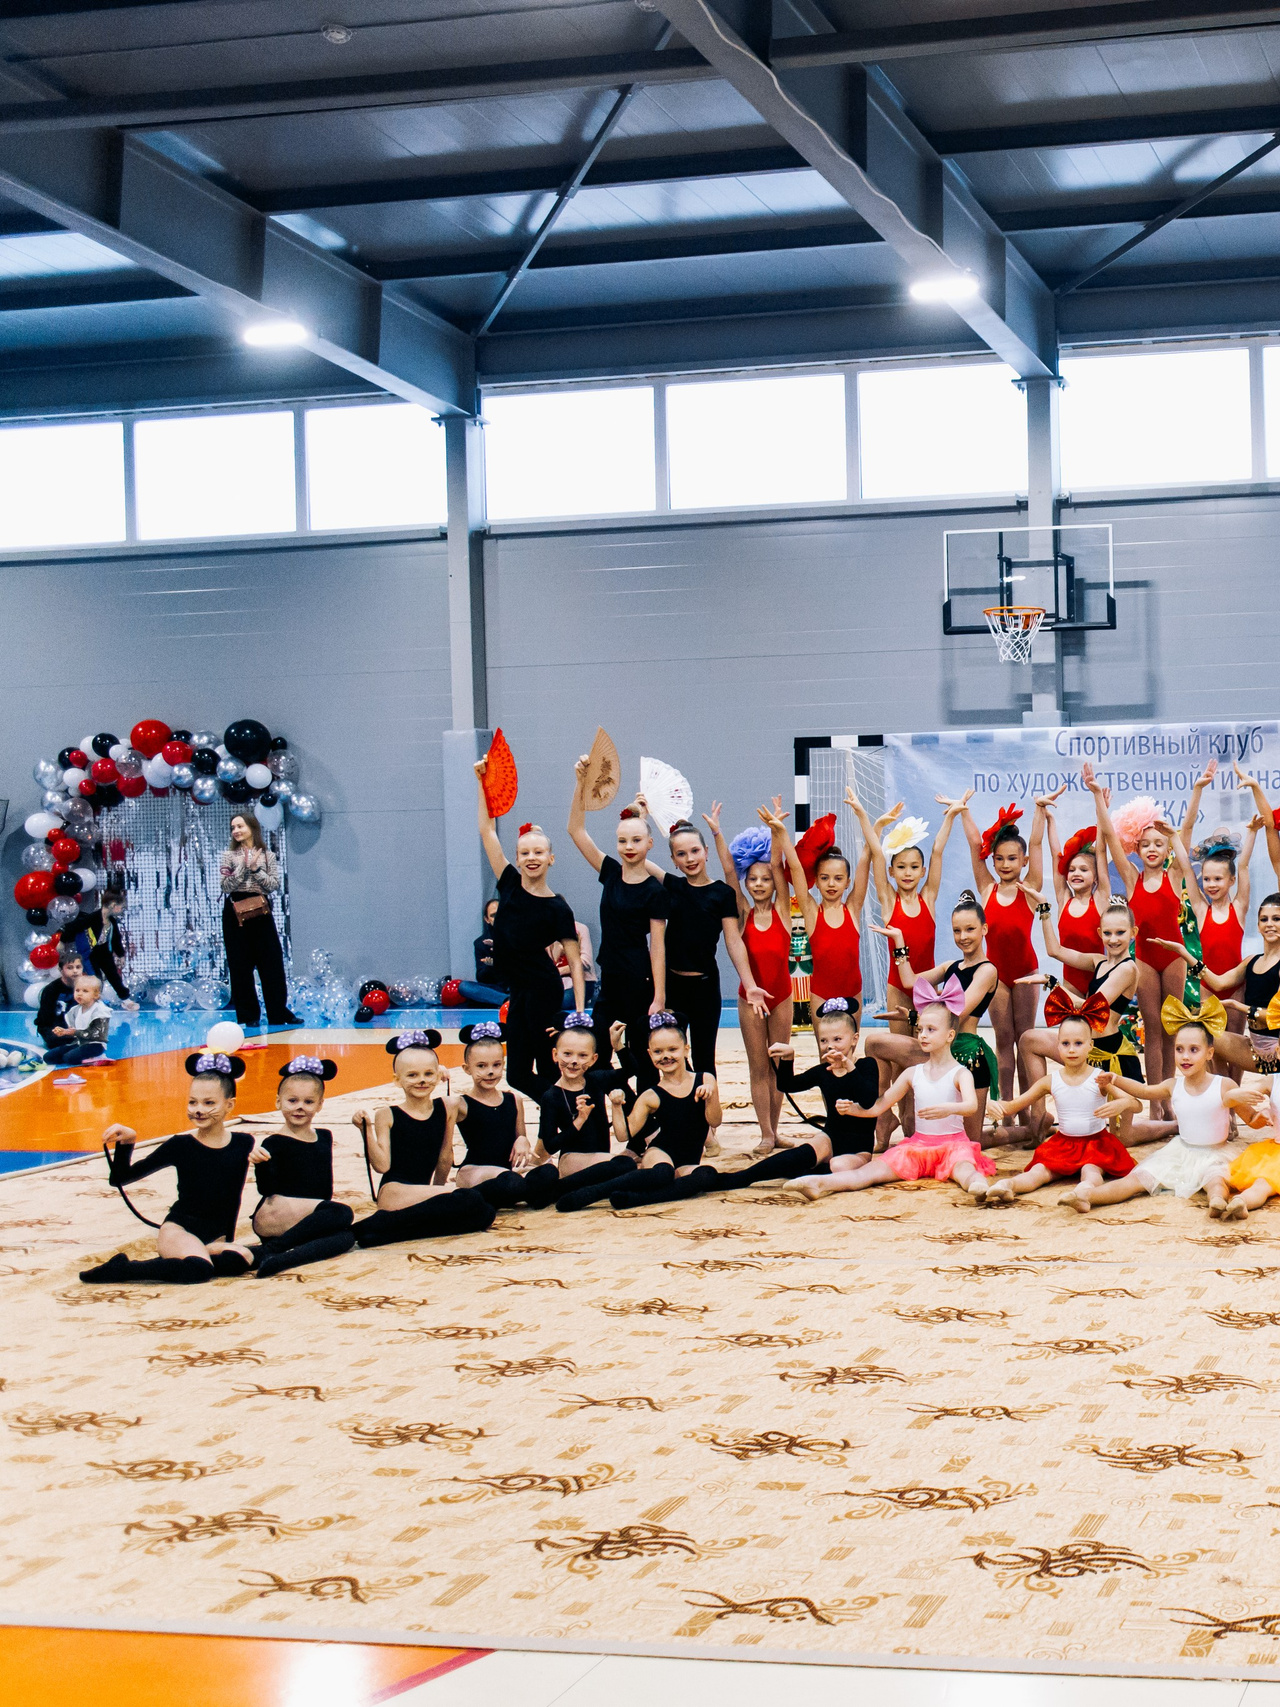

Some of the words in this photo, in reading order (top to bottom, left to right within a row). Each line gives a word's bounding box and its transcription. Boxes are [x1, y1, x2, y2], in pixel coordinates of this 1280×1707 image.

[1055, 728, 1200, 762] Спортивный
[1209, 726, 1264, 761] клуб
[974, 772, 1000, 792] по
